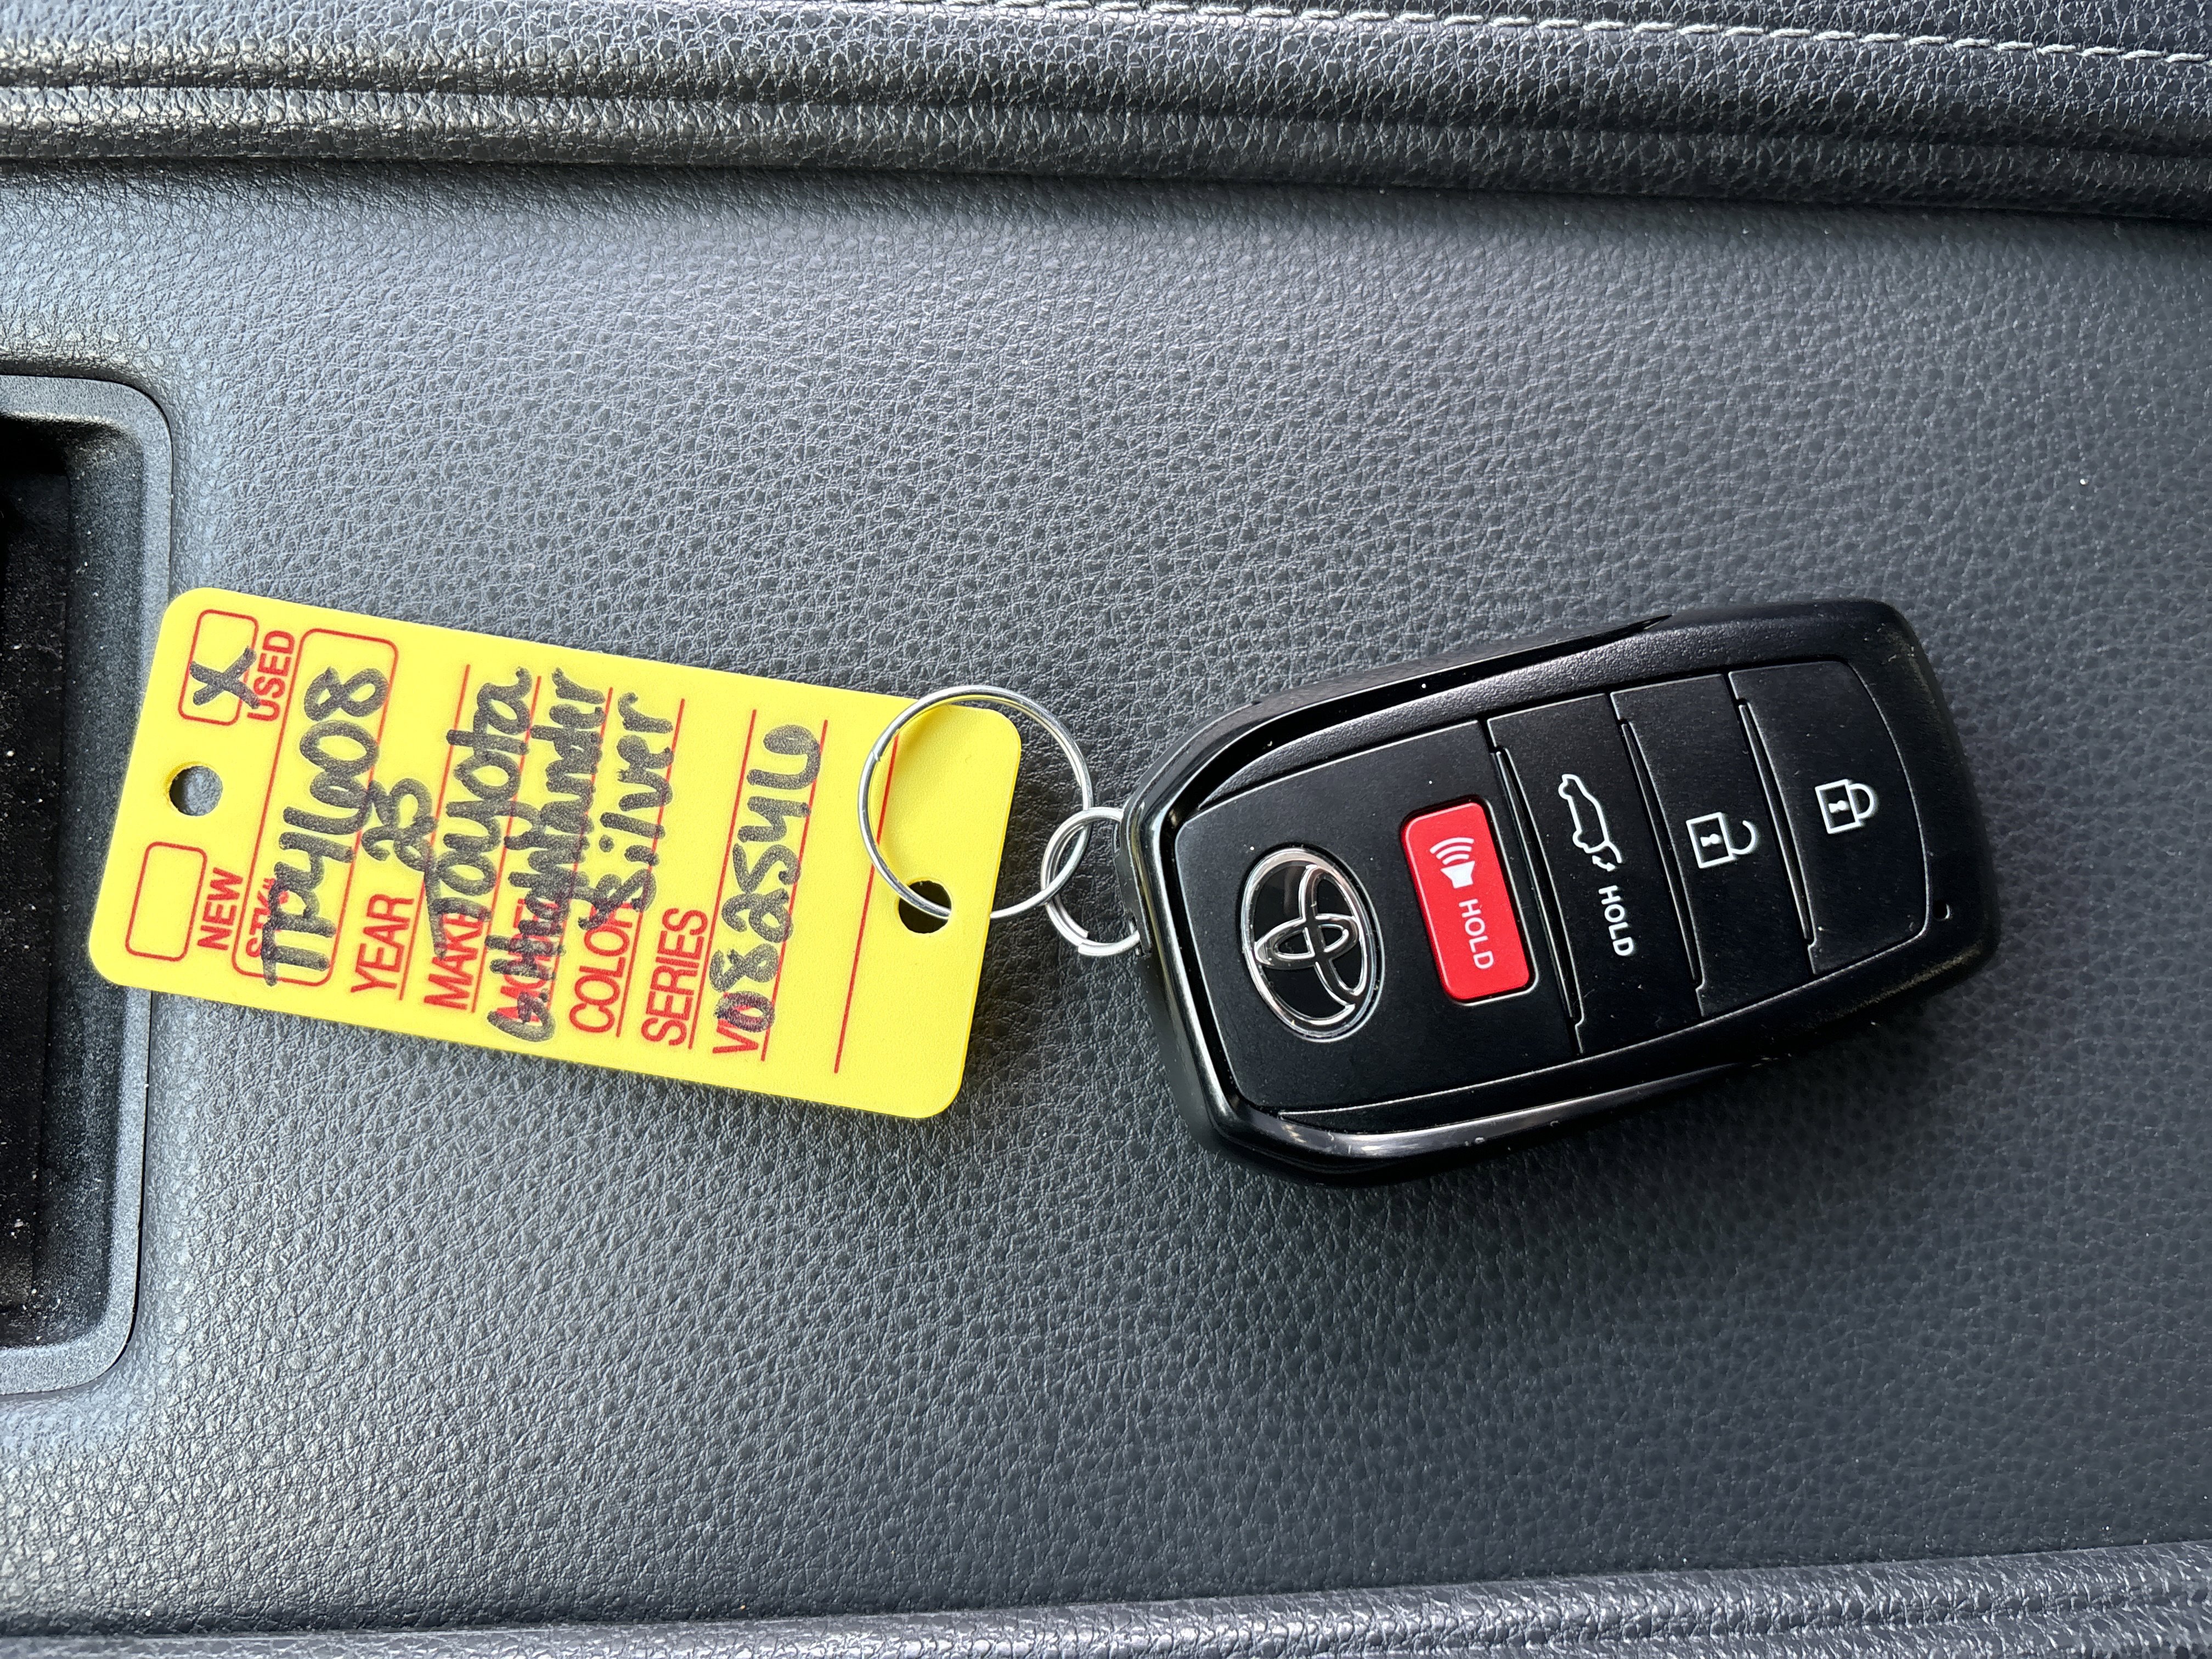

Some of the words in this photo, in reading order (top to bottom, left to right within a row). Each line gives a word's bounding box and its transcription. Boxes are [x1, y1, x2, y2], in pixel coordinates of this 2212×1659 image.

[247, 630, 295, 721] USED
[261, 666, 388, 986] TP4608
[424, 667, 540, 959] Toyota
[196, 867, 243, 951] NEW
[351, 893, 415, 993] YEAR
[1458, 898, 1494, 969] HOLD
[1598, 885, 1634, 956] HOLD
[641, 907, 708, 1047] SERIES
